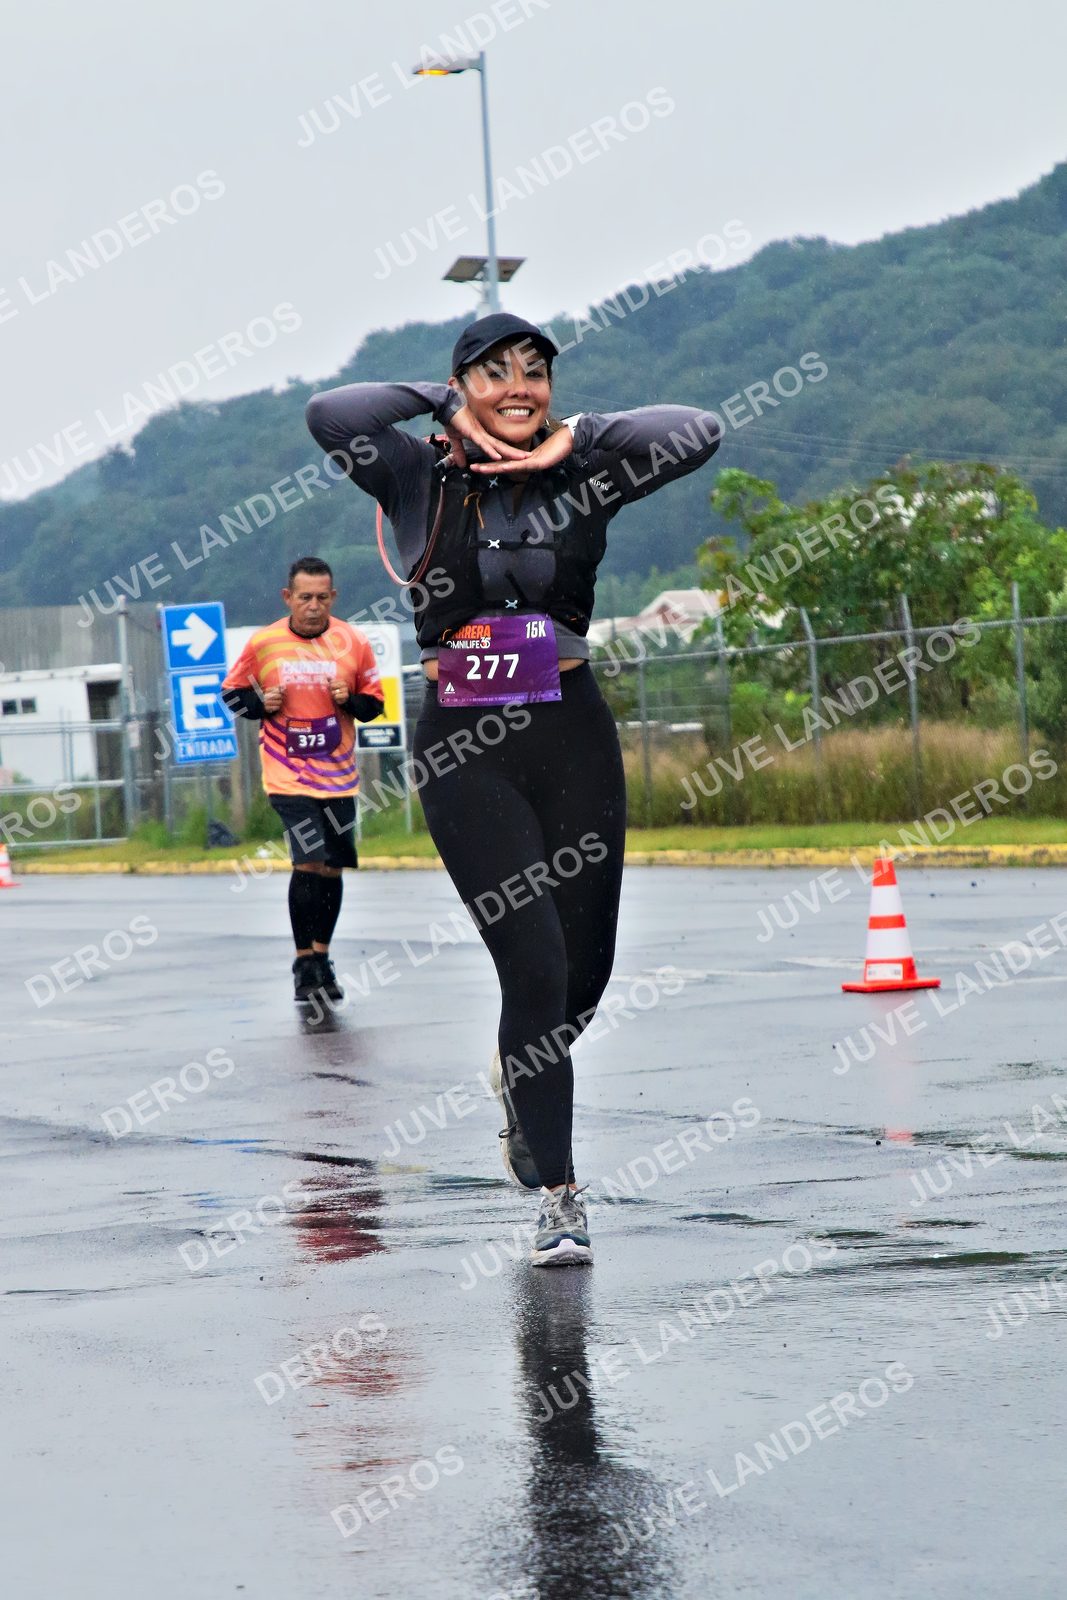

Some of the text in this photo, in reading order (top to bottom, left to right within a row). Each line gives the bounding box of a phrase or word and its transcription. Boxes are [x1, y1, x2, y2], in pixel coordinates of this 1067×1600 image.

[466, 653, 520, 680] 277
[180, 674, 224, 731] E
[178, 738, 234, 756] ENTRADA
[298, 733, 326, 746] 373
